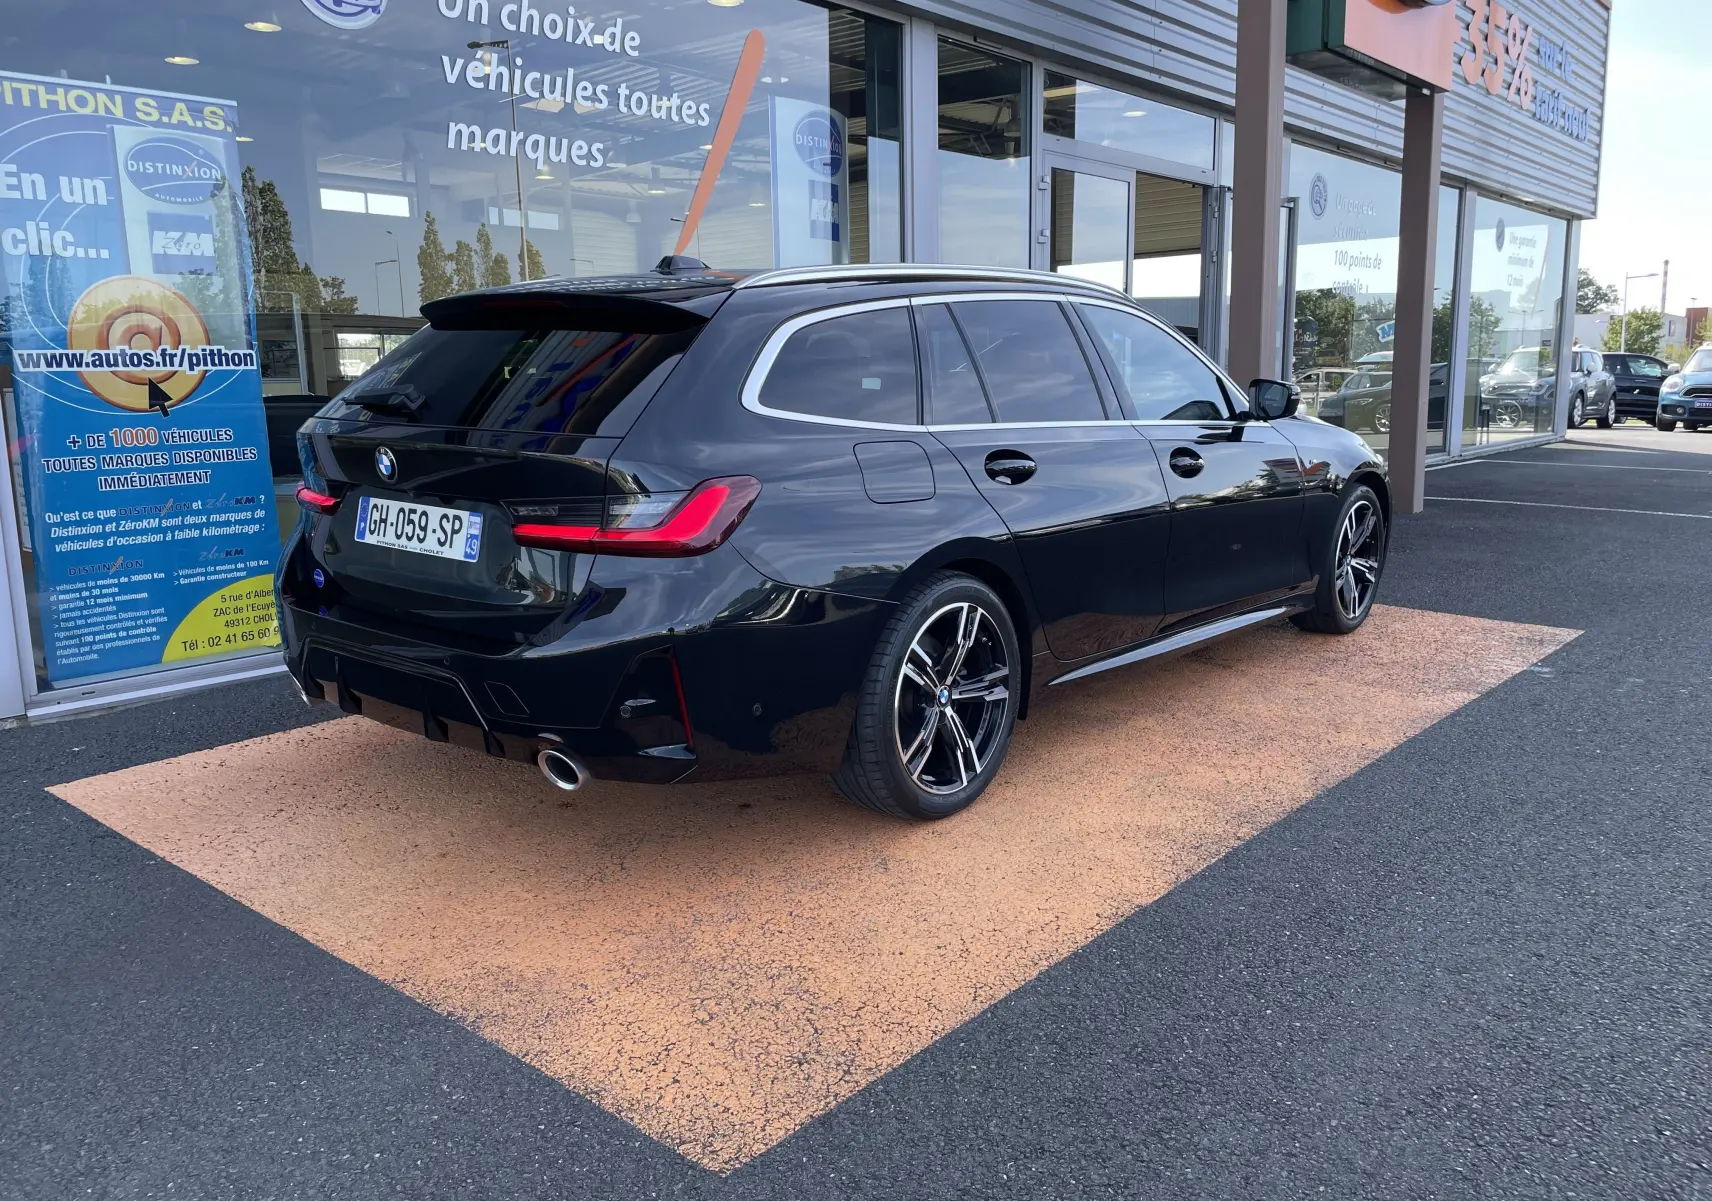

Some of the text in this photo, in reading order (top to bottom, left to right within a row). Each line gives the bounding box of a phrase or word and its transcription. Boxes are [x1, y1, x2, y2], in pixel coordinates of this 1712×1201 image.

[438, 0, 641, 57] Un choix de
[1538, 36, 1558, 73] sur
[441, 50, 711, 127] véhicules toutes
[0, 81, 233, 132] ITHON S.A.S.
[447, 121, 604, 170] marques
[127, 160, 222, 181] DISTINXION
[0, 163, 107, 205] En un
[155, 193, 203, 203] AUTOMOBILE
[1, 220, 110, 259] clic...
[1334, 249, 1382, 271] 100 points de
[18, 348, 255, 372] www.autos.fr/pithon
[86, 434, 106, 448] DE
[109, 427, 159, 447] 1000
[161, 428, 234, 445] VÉHICULES
[42, 447, 258, 474] TOUTES MARQUES DISPONIBLES
[98, 470, 211, 491] IMMÉDIATEMENT
[82, 511, 94, 520] ce
[97, 509, 117, 520] que
[119, 498, 190, 516] DISTINXION
[192, 500, 202, 510] et
[259, 495, 265, 504] ?
[50, 508, 266, 538] Distinxion et ZéroKM sont deux marques de
[368, 503, 463, 549] GH-059-SP
[55, 538, 104, 552] véhicules
[106, 532, 163, 547] d'occasion
[165, 530, 172, 541] à
[174, 527, 200, 540] faible
[376, 540, 396, 548] PITHON
[419, 547, 445, 556] CHOLET
[465, 538, 478, 556] 49
[68, 556, 144, 576] DISTINXION
[178, 566, 206, 576] Véhicules
[215, 563, 235, 571] moins
[236, 561, 245, 569] de
[56, 582, 87, 591] véhicules
[97, 578, 119, 586] moins
[130, 573, 152, 581] 30000
[179, 575, 206, 584] Garantie
[206, 571, 247, 581] constructeur
[58, 592, 80, 600] moins
[102, 586, 119, 594] mois
[115, 592, 148, 602] minimum
[220, 594, 227, 603] 5
[229, 594, 243, 602] rue
[60, 610, 81, 620] jamais
[118, 609, 150, 619] Distinxion
[151, 607, 165, 615] sont
[213, 606, 231, 617] ZAC
[233, 605, 244, 614] de
[224, 612, 277, 628] 49312 CHOL
[81, 635, 94, 643] 100
[95, 632, 117, 642] points
[181, 639, 199, 652] Tél
[207, 635, 222, 648] 02
[225, 632, 237, 644] 41
[241, 630, 255, 642] 65
[257, 628, 271, 639] 60
[80, 645, 91, 653] par
